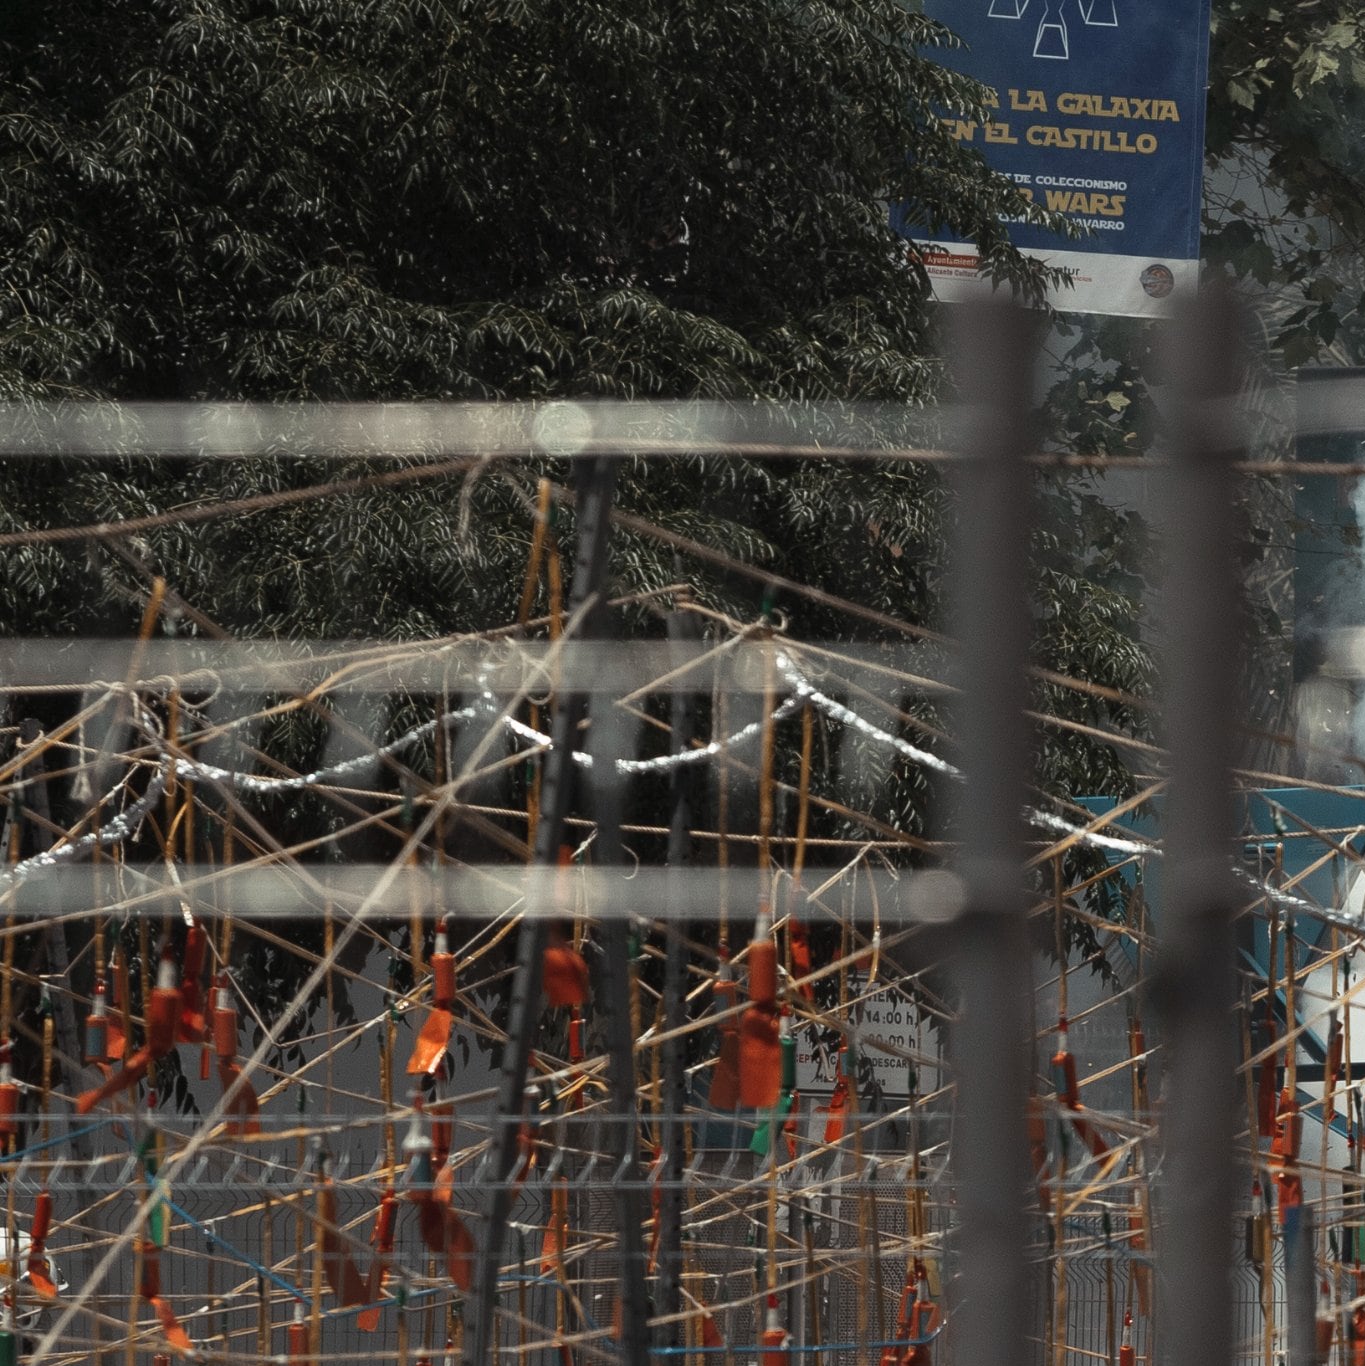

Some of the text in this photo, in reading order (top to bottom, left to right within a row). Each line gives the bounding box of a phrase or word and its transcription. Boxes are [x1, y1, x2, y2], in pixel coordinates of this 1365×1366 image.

[1008, 88, 1048, 112] LA
[1057, 92, 1180, 122] GALAXIA
[984, 123, 1018, 144] EL
[1026, 125, 1157, 154] CASTILLO
[1014, 173, 1032, 184] DE
[1035, 176, 1128, 191] COLECCIONISMO
[1045, 189, 1126, 216] WARS
